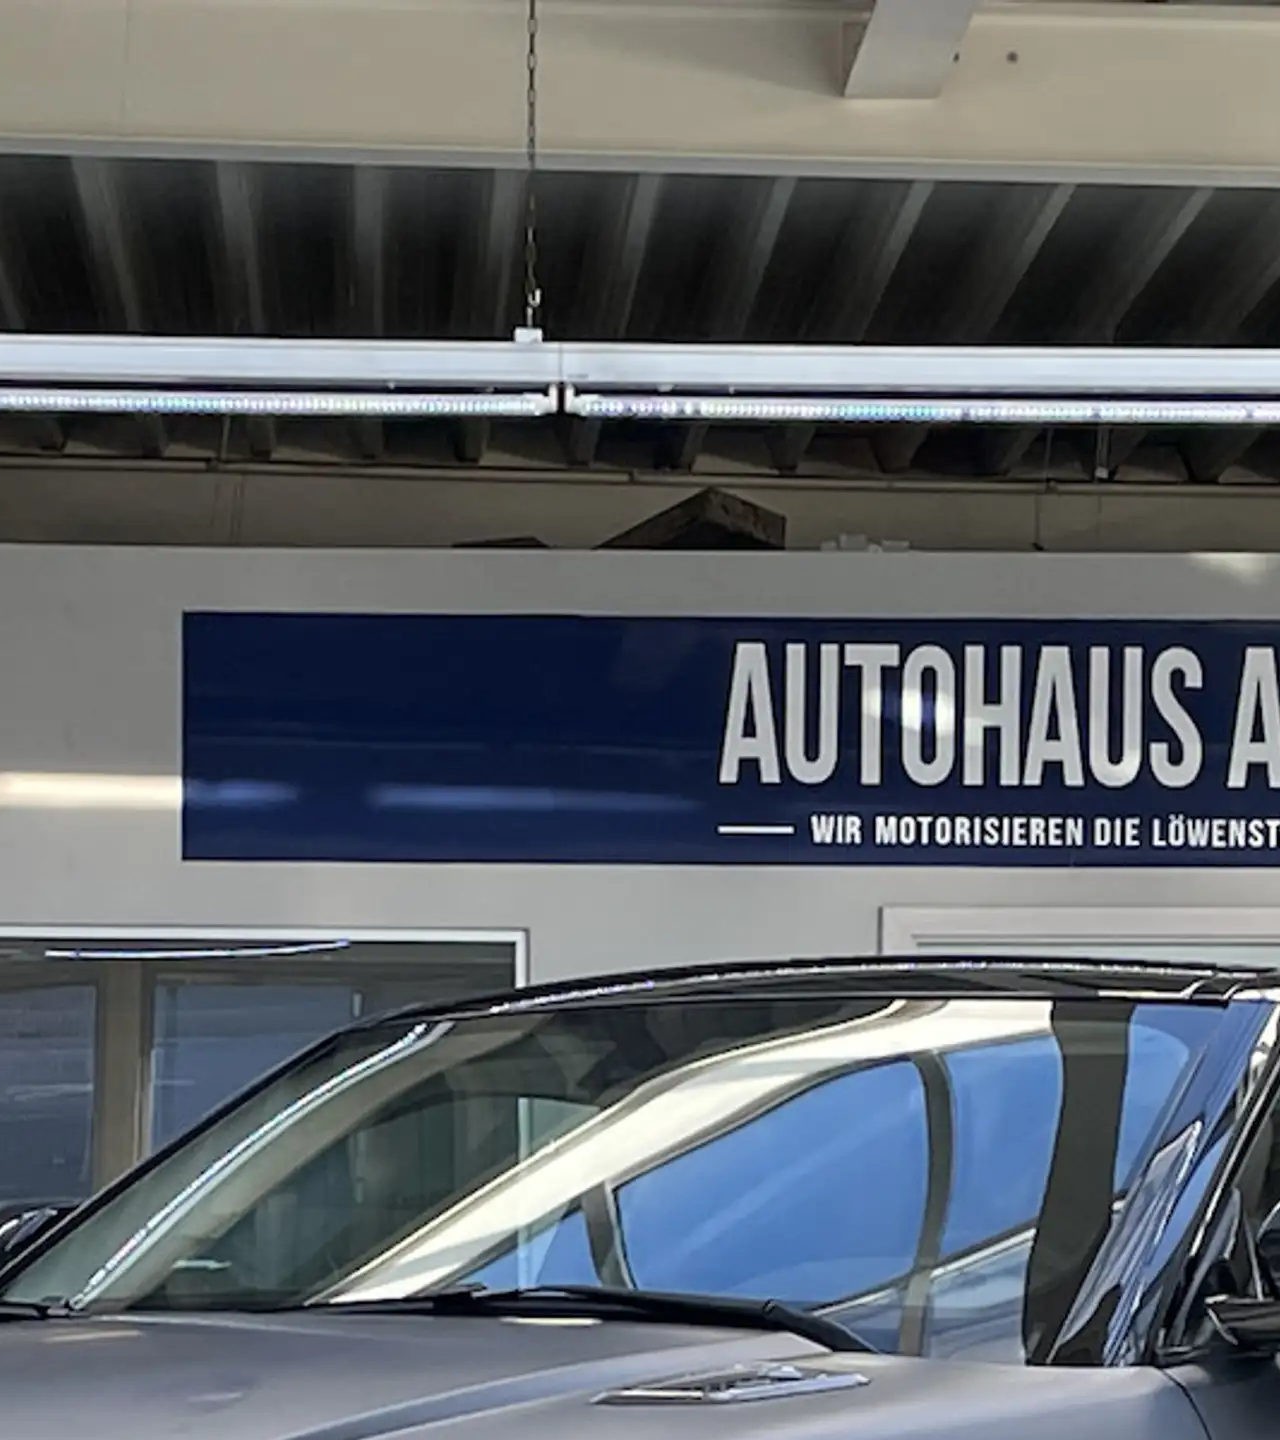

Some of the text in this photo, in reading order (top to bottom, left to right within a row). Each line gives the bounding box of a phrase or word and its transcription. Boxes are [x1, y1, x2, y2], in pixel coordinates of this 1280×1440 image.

[719, 641, 1204, 788] AUTOHAUS
[811, 816, 862, 845] WIR
[875, 817, 1083, 848] MOTORISIEREN
[1095, 819, 1140, 847] DIE
